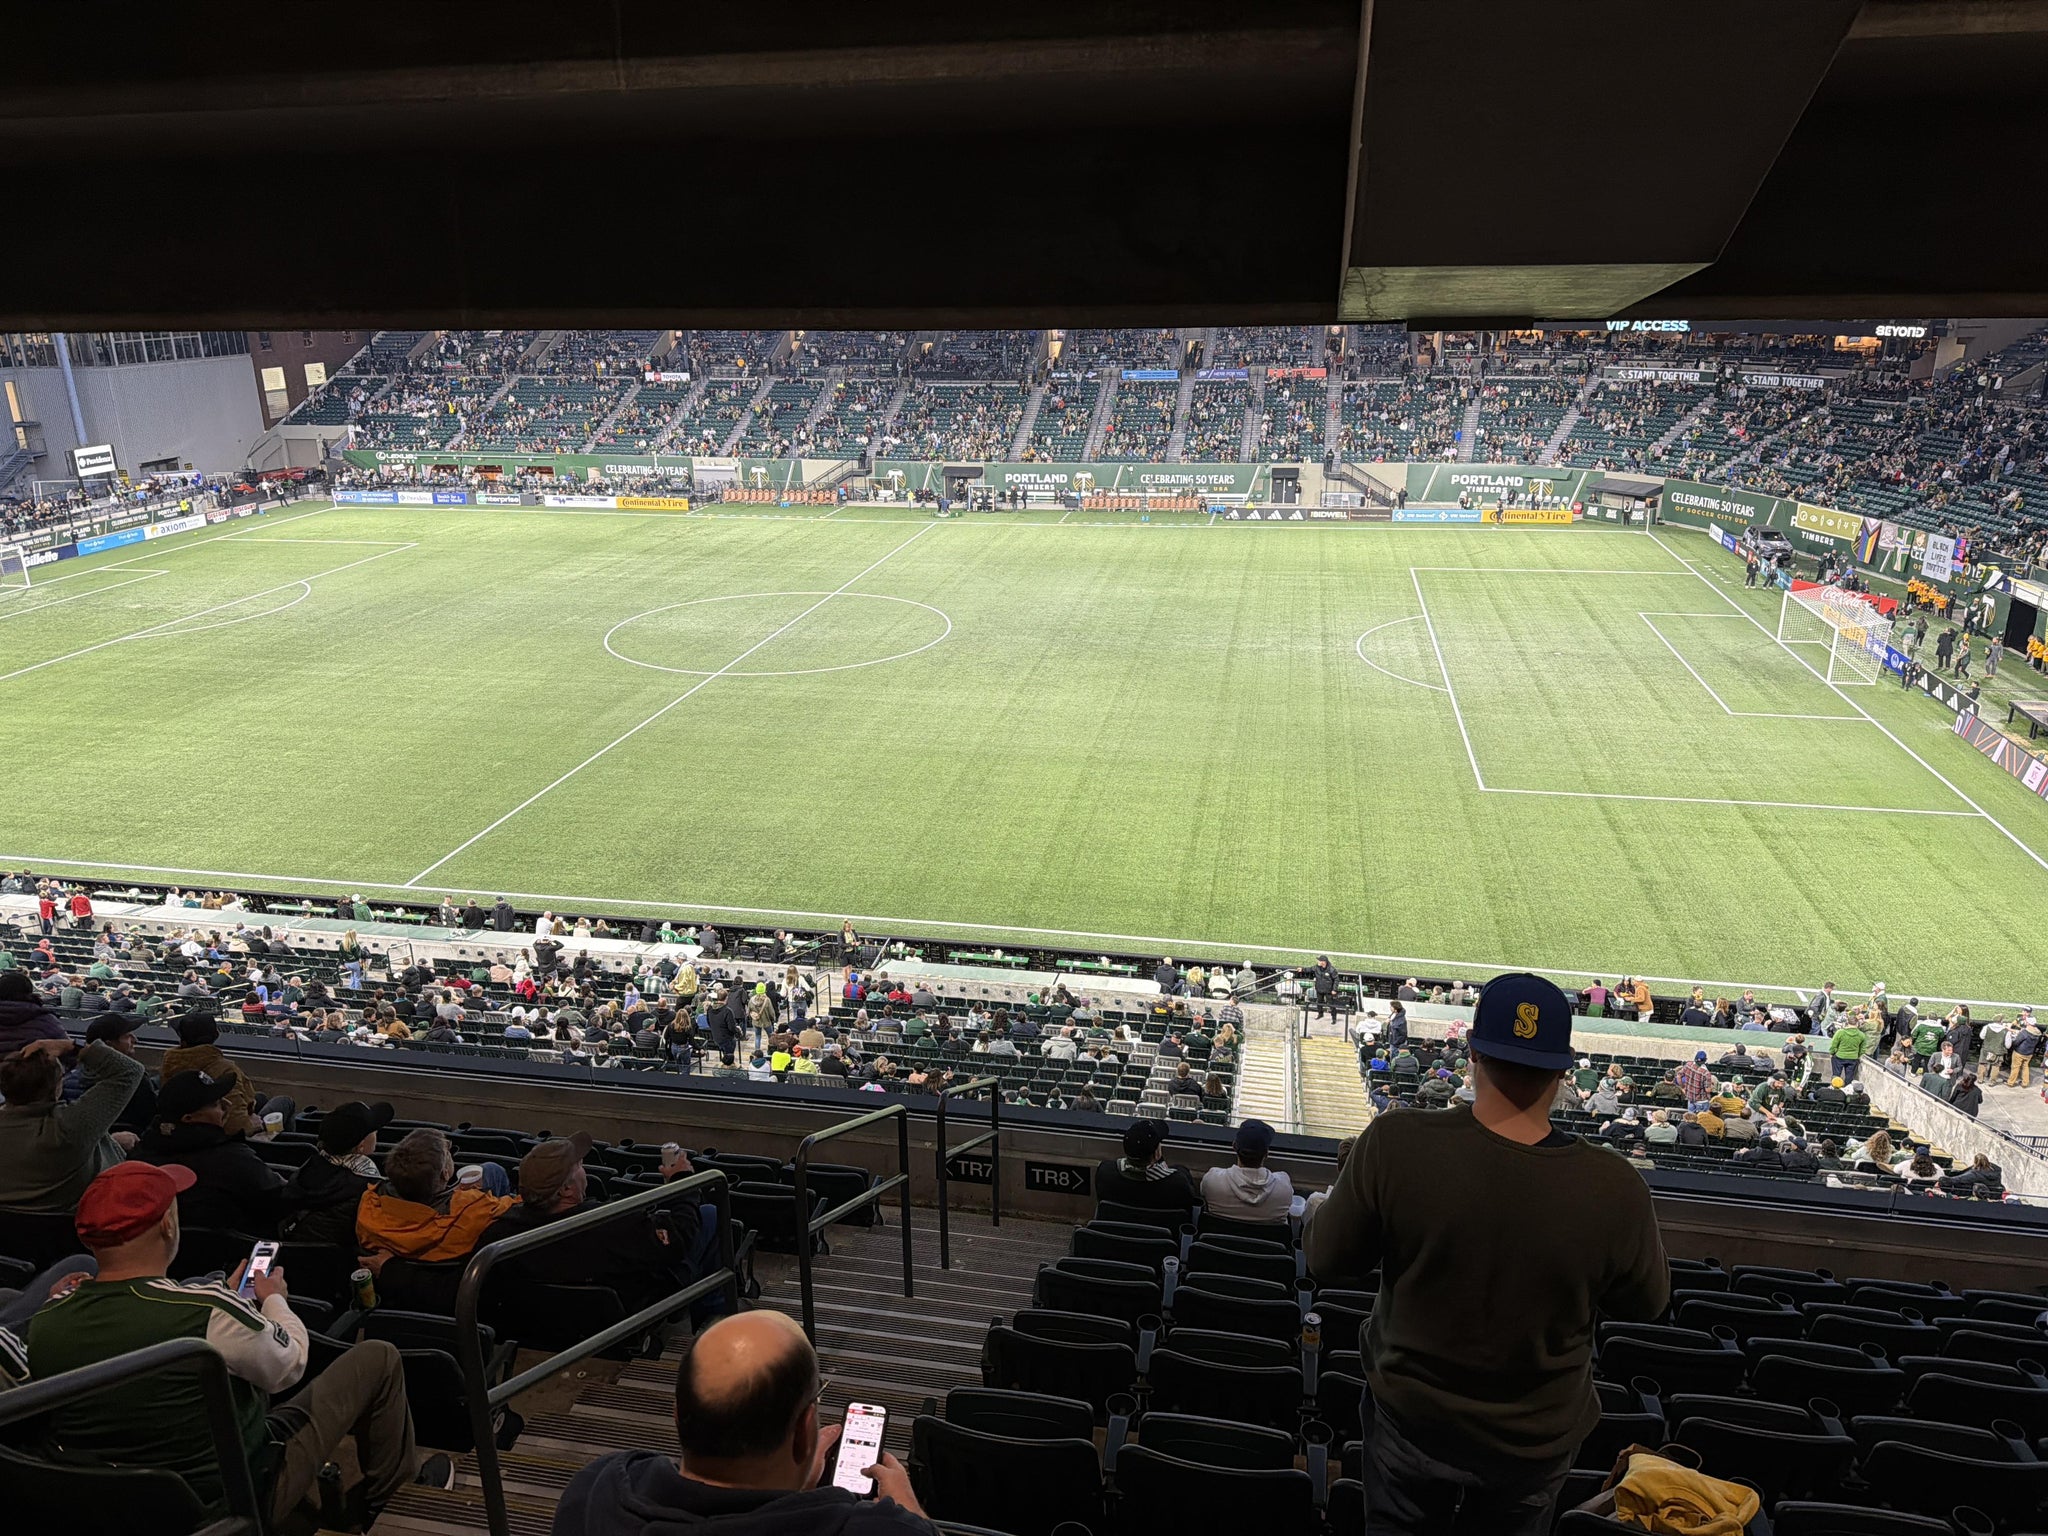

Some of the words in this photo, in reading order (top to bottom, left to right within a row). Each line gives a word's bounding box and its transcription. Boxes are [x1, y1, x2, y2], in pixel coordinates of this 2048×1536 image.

[1606, 320, 1630, 331] VIP
[1631, 320, 1691, 332] ACCESS,
[1875, 325, 1926, 338] BEYOND
[1627, 370, 1656, 381] STAND
[1658, 371, 1700, 382] TOGETHER
[1752, 375, 1780, 386] STAND
[1782, 376, 1824, 388] TOGETHER
[605, 464, 652, 476] CELEBRATING
[666, 465, 689, 476] YEARS
[1005, 473, 1068, 484] PORTLAND
[1140, 474, 1194, 485] CELEBRATING
[1195, 475, 1207, 485] 50
[1208, 474, 1235, 485] YEARS
[1451, 474, 1524, 488] PORTLAND
[1466, 486, 1508, 495] TIMBERS
[233, 502, 257, 514] DISCOUNT
[622, 499, 661, 508] Continental
[667, 499, 684, 508] Tire
[1671, 491, 1721, 511] CELEBRATING
[1720, 500, 1732, 514] 50
[1732, 502, 1755, 518] YEARS
[206, 508, 231, 521] DISCOUNT
[1313, 511, 1348, 520] BIDWELL
[1545, 510, 1567, 521] Tire
[1687, 507, 1714, 519] SOCCER
[1716, 513, 1732, 522] CITY
[1734, 517, 1748, 526] USA
[160, 521, 187, 534] axiom
[1801, 530, 1835, 547] TIMBERS
[1513, 1002, 1540, 1040] S
[956, 1160, 993, 1178] TR7
[1031, 1168, 1070, 1187] TR8
